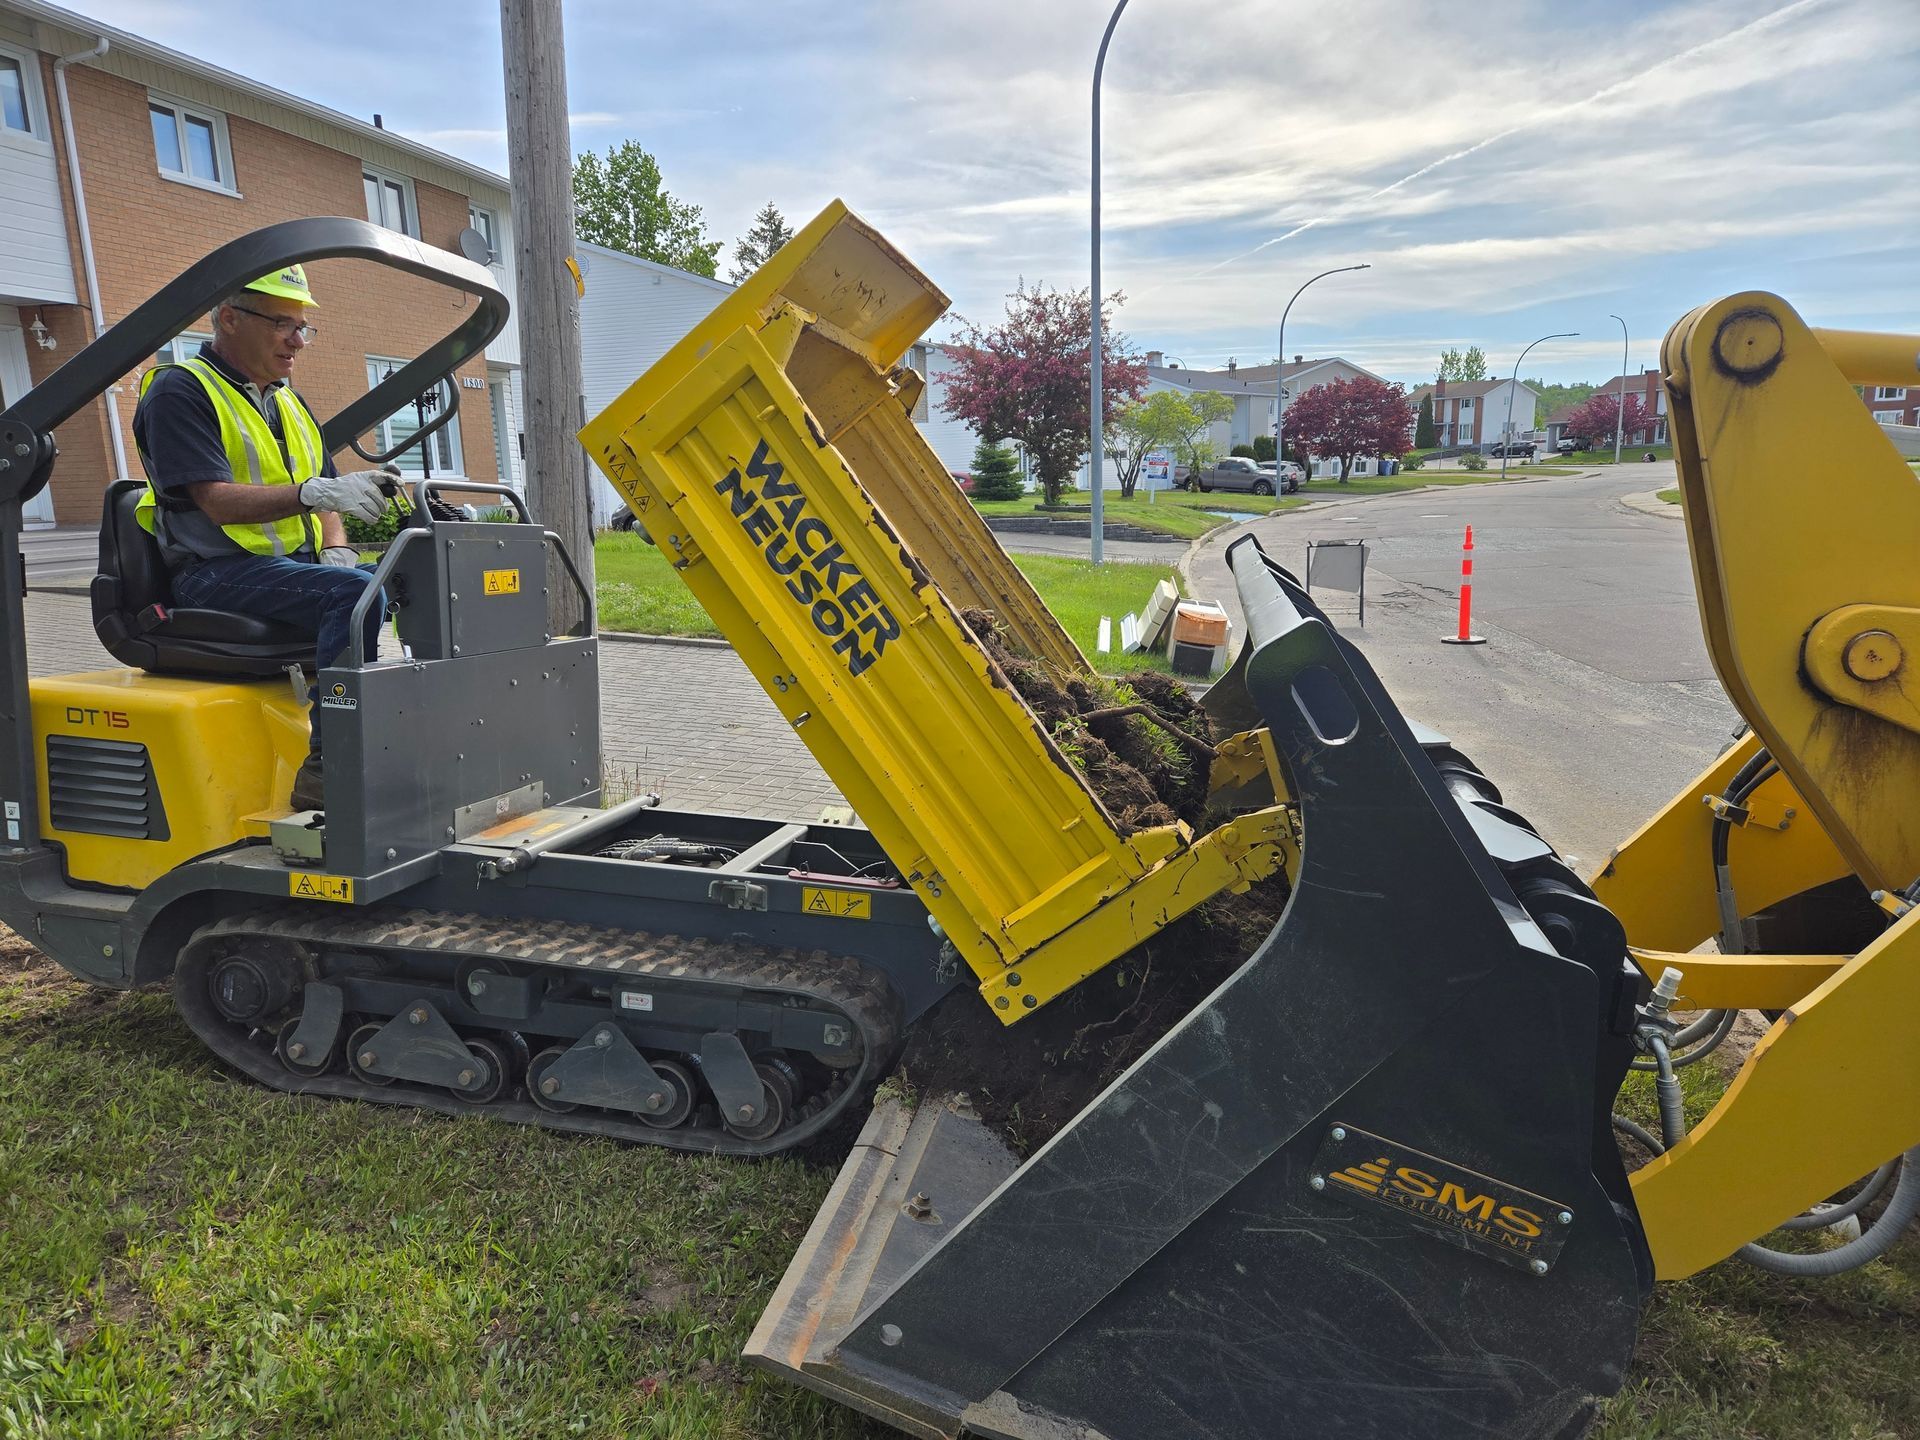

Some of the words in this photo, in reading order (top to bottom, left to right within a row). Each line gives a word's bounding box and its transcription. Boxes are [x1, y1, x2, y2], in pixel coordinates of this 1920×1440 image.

[713, 467, 877, 678] NEUSON
[745, 438, 901, 657] WACKER
[322, 697, 357, 707] MILLER
[1390, 1167, 1545, 1238] SMS
